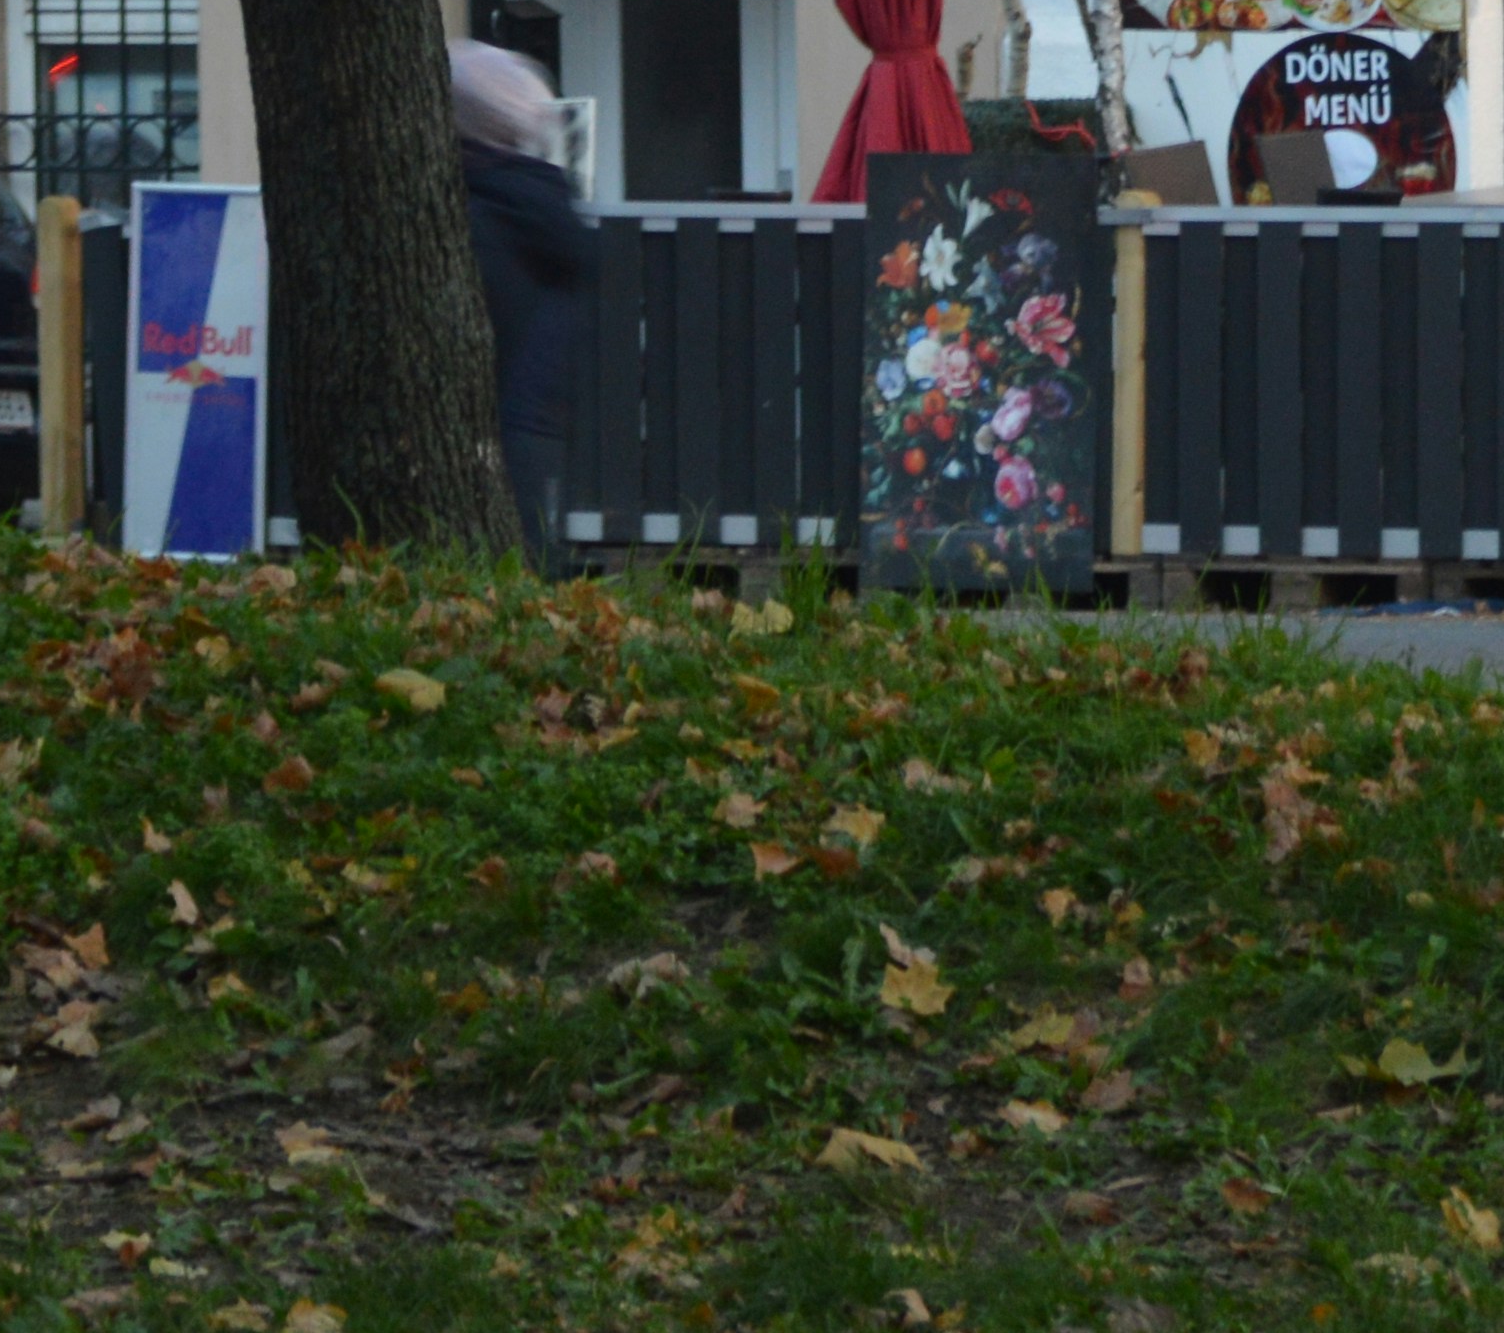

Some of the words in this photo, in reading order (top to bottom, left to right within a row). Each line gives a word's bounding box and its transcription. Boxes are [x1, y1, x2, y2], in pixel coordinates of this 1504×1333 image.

[1284, 43, 1390, 84] DÖNER
[1303, 85, 1392, 127] MENÜ
[144, 322, 198, 355] Red
[201, 324, 254, 356] Bull
